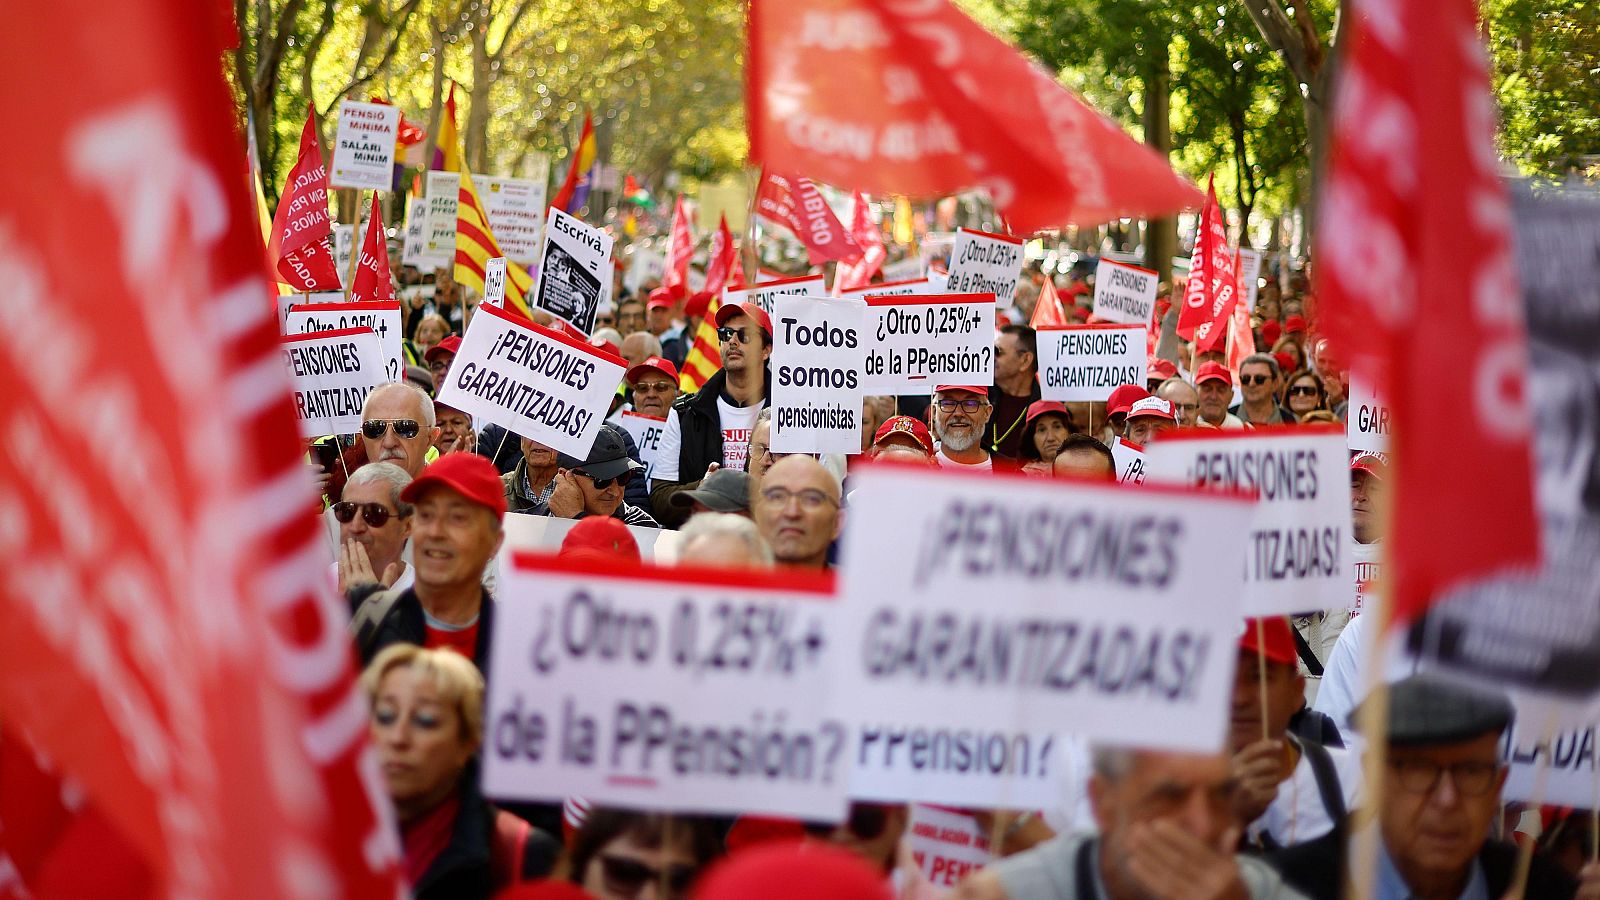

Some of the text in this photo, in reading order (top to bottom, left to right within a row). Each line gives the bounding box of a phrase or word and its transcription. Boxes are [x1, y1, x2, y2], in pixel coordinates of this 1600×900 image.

[554, 213, 605, 257] Escrivà,
[960, 240, 986, 266] ¿Otro
[947, 270, 959, 291] de
[959, 272, 970, 293] la
[781, 318, 858, 348] Todos
[876, 306, 981, 342] ¿Otro 0,25%+
[487, 329, 595, 391] ¡PENSIONES
[865, 346, 991, 375] de la PPensión?
[1056, 334, 1127, 360] ¡PENSIONES
[778, 366, 858, 389] somos
[1046, 366, 1139, 387] GARANTIZADAS!
[457, 362, 593, 439] GARANTIZADAS!
[777, 402, 856, 434] pensionistas.
[1253, 527, 1341, 582] TIZADAS!
[531, 589, 825, 681] ¿Otro 0,25%+
[863, 608, 1211, 700] GARANTIZADAS!
[495, 692, 845, 785] de la PPensión?
